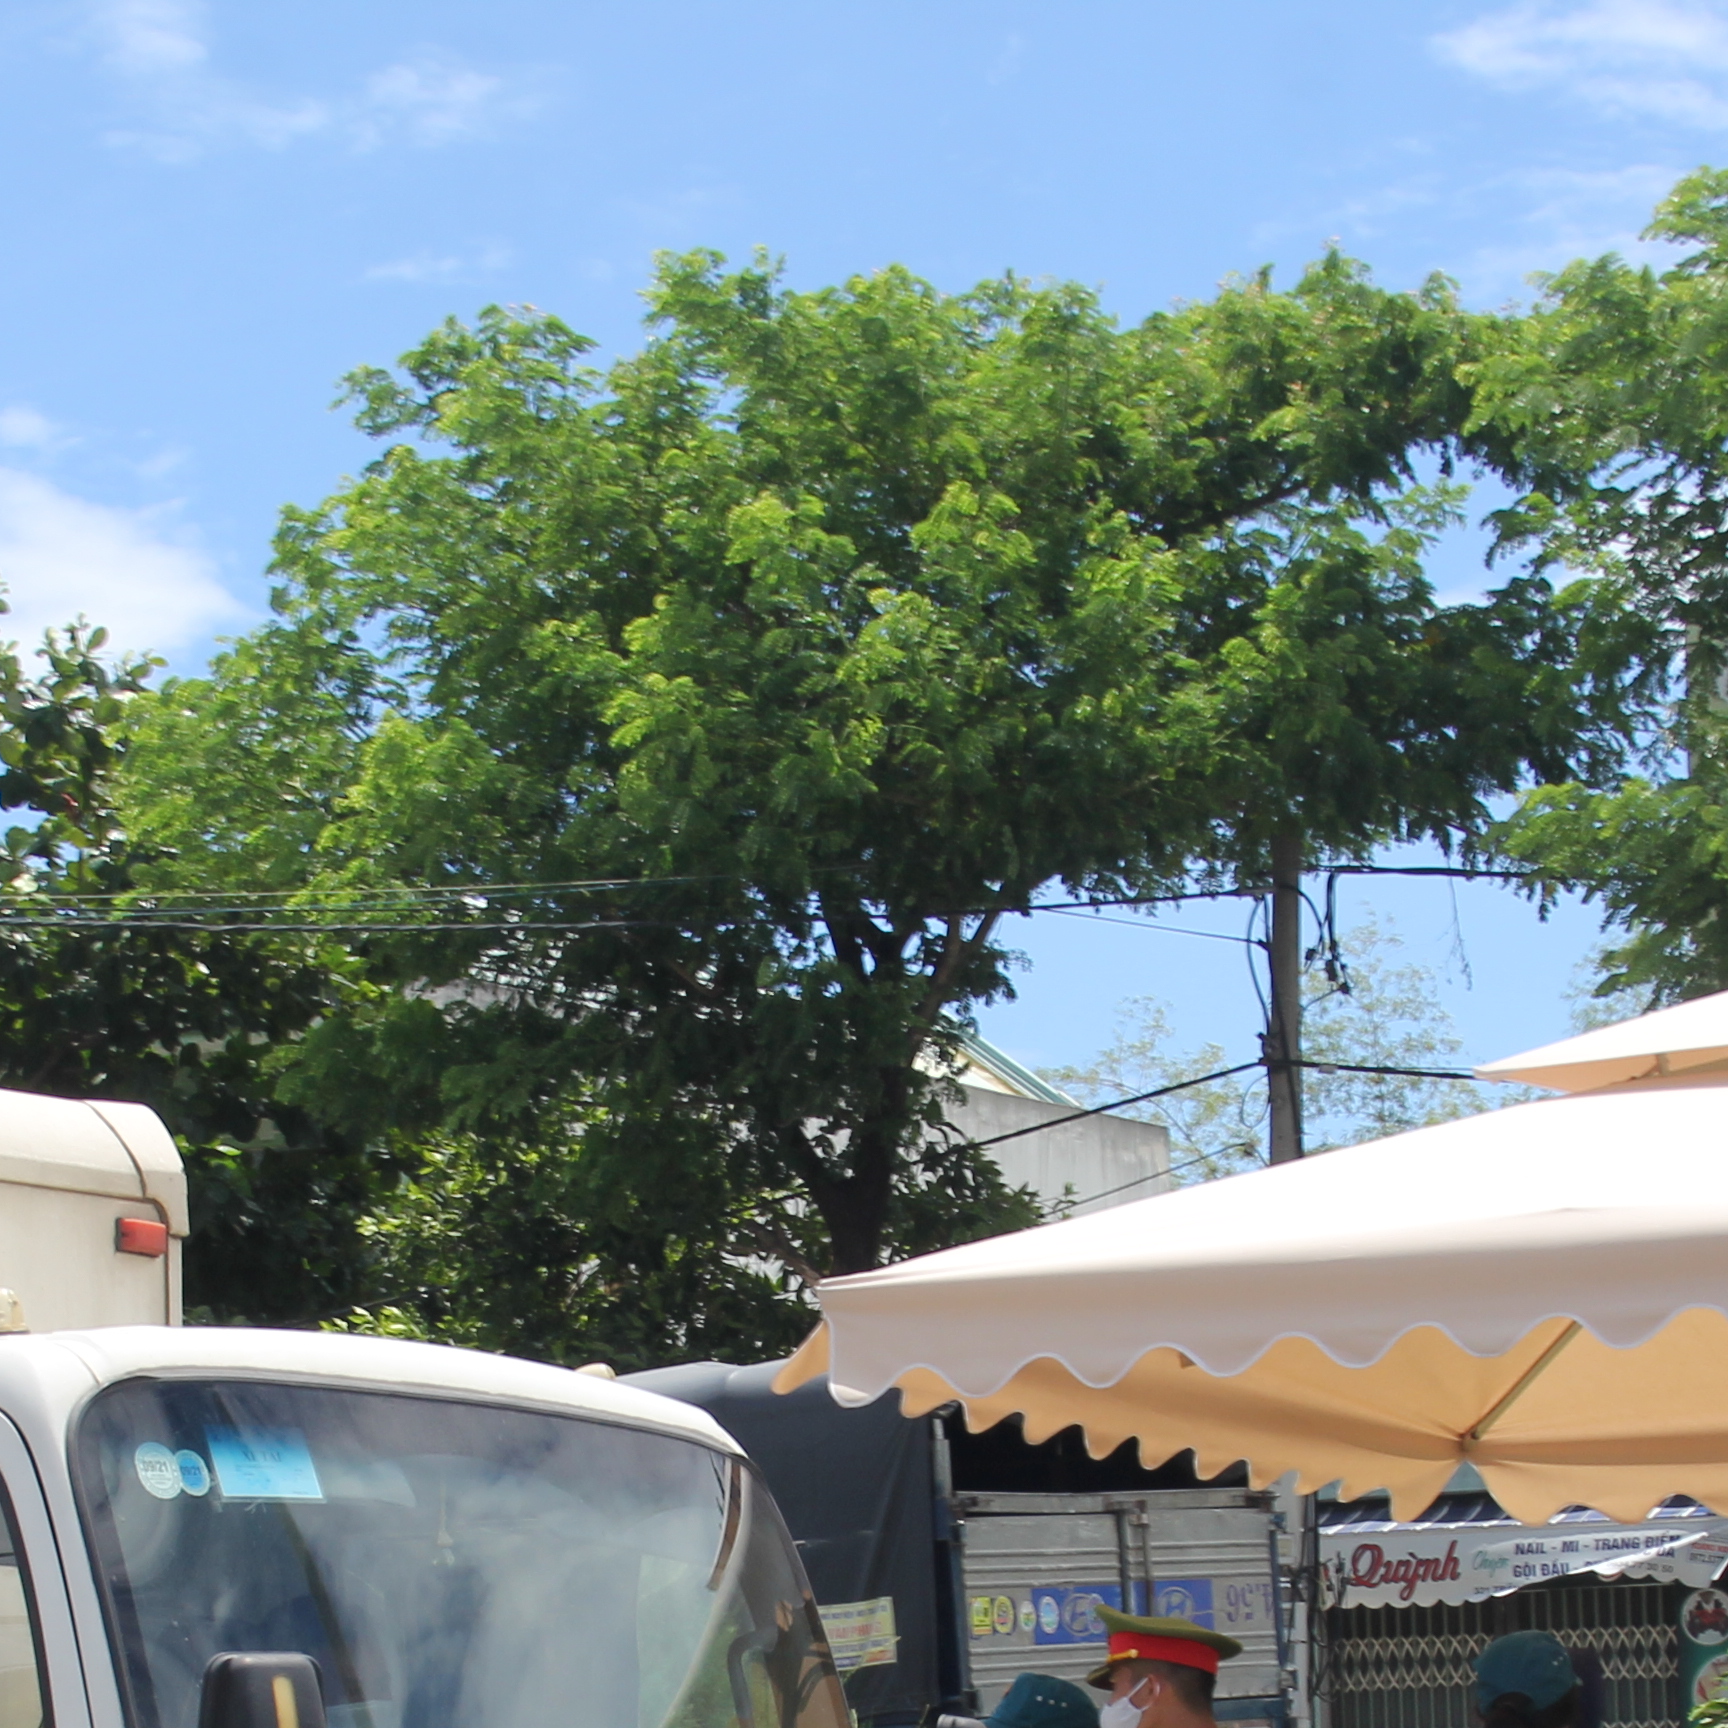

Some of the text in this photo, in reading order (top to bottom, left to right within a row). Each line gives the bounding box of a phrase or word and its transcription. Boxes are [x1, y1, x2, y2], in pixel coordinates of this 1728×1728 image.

[1515, 1542, 1547, 1555] NAIL
[1594, 1537, 1640, 1551] TRANG
[1351, 1540, 1461, 1601] Quỳnh
